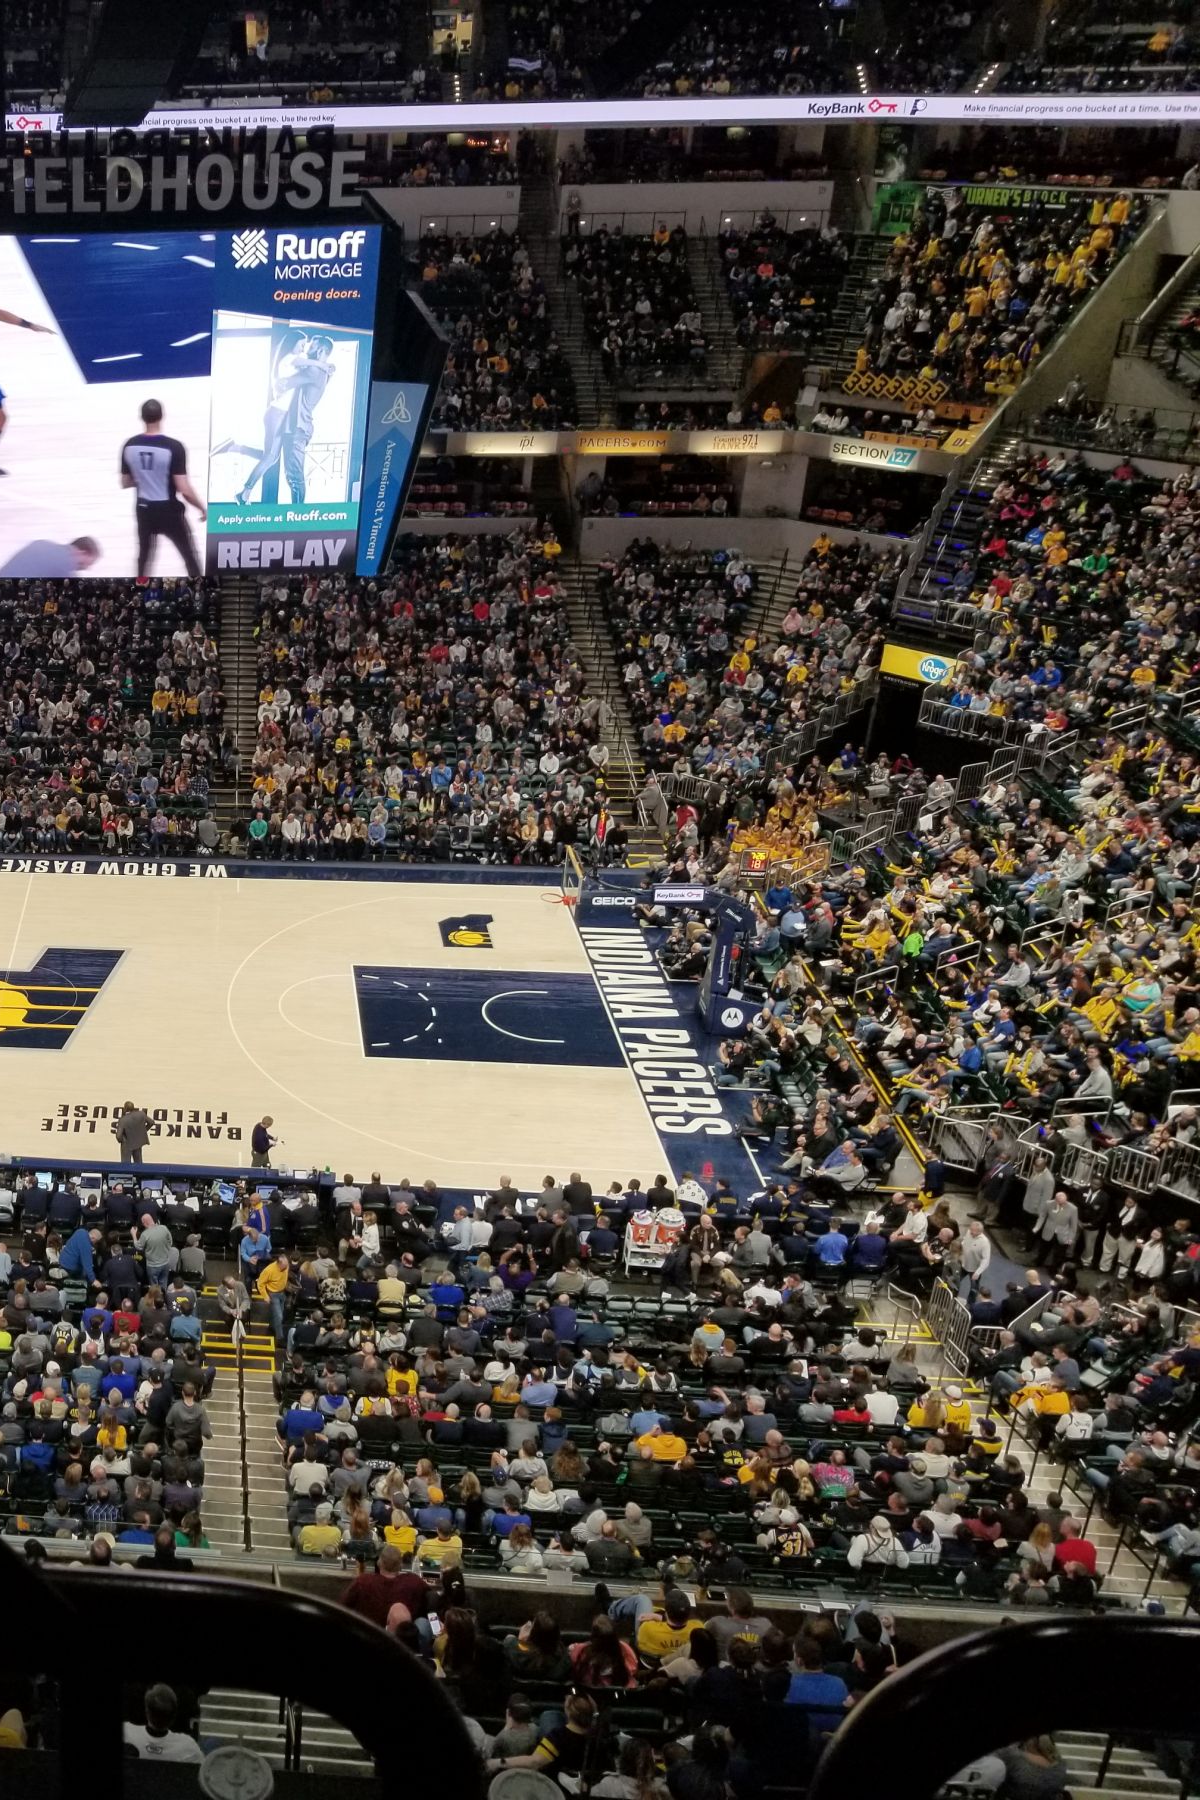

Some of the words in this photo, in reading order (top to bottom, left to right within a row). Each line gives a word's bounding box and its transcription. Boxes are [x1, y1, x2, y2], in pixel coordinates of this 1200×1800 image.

[807, 102, 865, 116] KeyBank
[963, 104, 985, 113] Make
[988, 104, 1023, 113] financial
[1025, 105, 1064, 114] progress
[1085, 104, 1116, 113] bucket
[1119, 105, 1128, 113] at
[1138, 104, 1161, 113] time.
[1165, 105, 1182, 113] Use
[1183, 104, 1198, 113] the
[162, 118, 196, 127] progress
[275, 231, 366, 262] Ruoff
[274, 263, 362, 280] MORTGAGE
[274, 290, 322, 303] Opening
[326, 289, 361, 300] doors.
[833, 442, 889, 460] SECTION
[891, 451, 911, 464] 127
[378, 439, 397, 492] Ascension
[373, 493, 387, 515] St.
[217, 514, 243, 525] Apply
[245, 513, 271, 523] online
[274, 513, 283, 522] at
[286, 511, 347, 523] Ruoff.com
[366, 516, 385, 561] Vincent
[217, 538, 347, 569] REPLAY
[921, 660, 947, 679] Kroger
[98, 861, 177, 876] GROW
[189, 863, 228, 878] WE
[591, 896, 636, 906] GEICO
[656, 890, 685, 899] KeyBank
[579, 926, 680, 1019] INDIANA
[619, 1027, 733, 1136] PACERS
[41, 1118, 97, 1134] LIFE
[782, 1541, 801, 1556] 31
